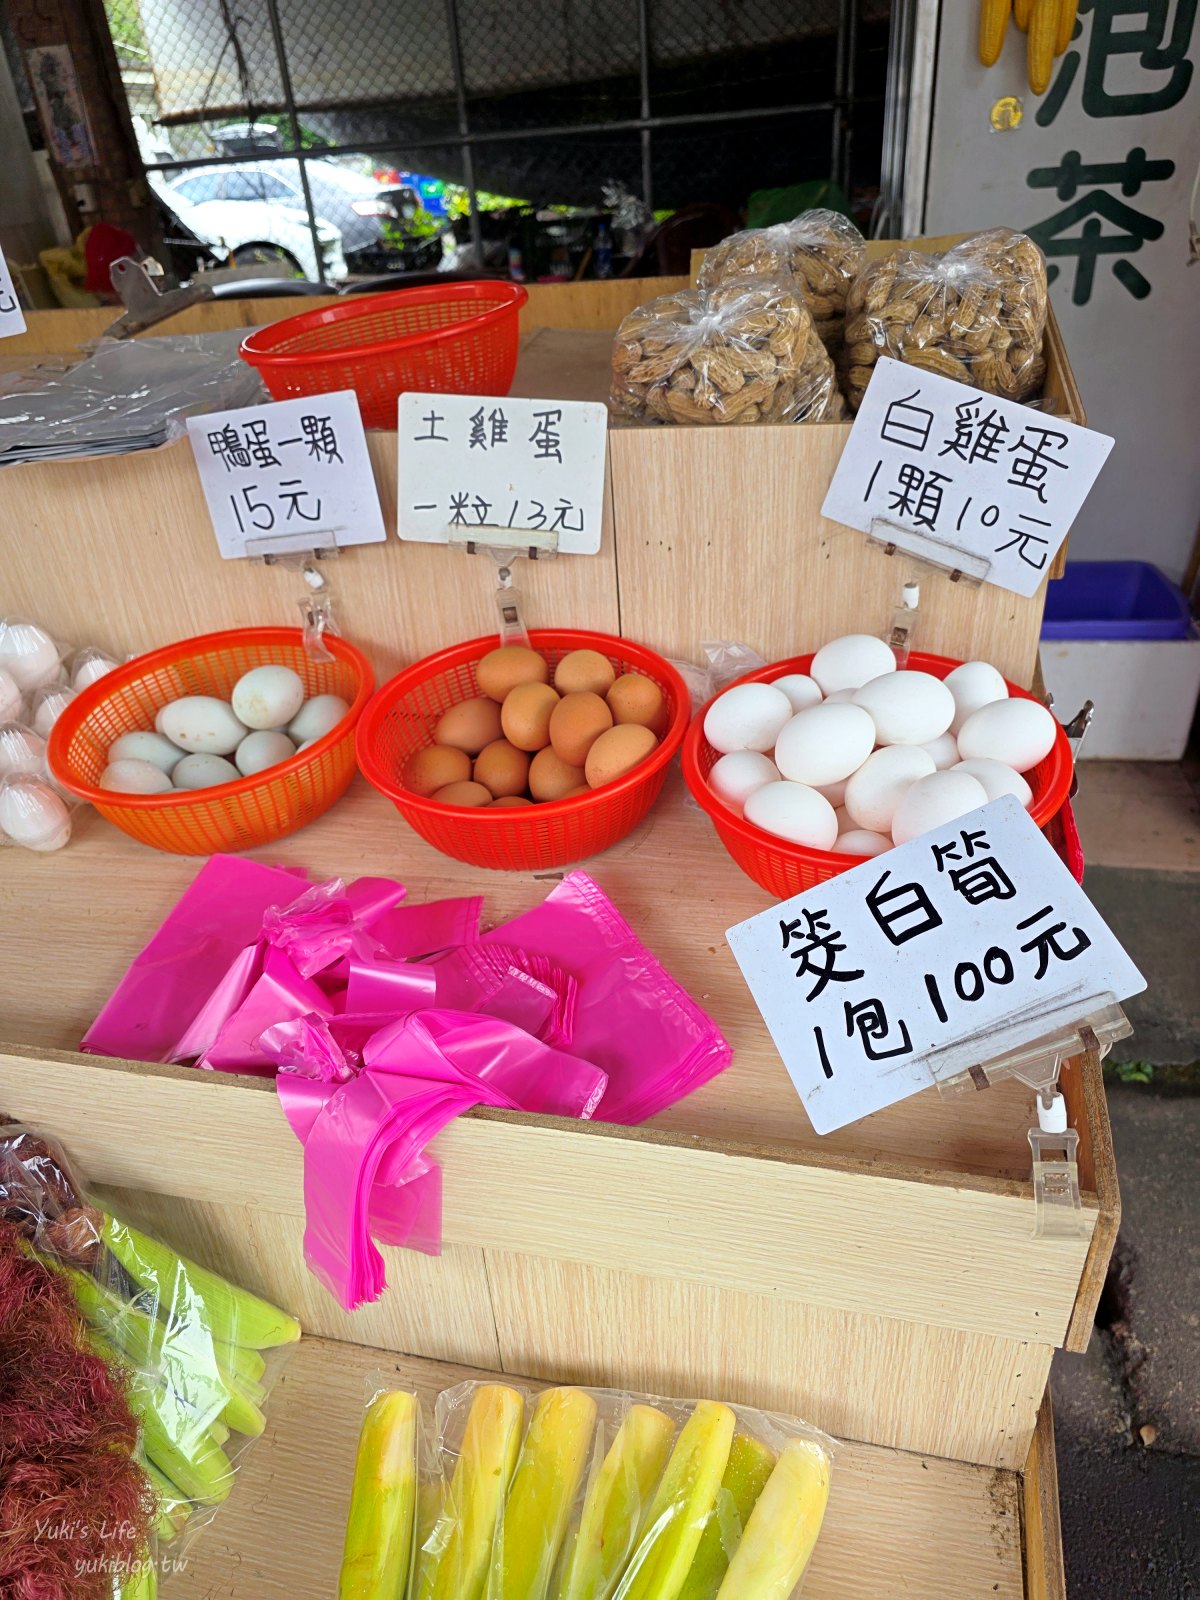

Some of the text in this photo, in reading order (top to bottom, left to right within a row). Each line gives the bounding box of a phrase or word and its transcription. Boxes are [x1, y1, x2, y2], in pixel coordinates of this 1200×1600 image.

[1021, 0, 1198, 306] 泡茶
[207, 414, 344, 473] 鴨蛋一顆
[413, 406, 563, 464] 土雞蛋
[880, 388, 1070, 504] 白雞蛋
[230, 478, 323, 534] 15元
[413, 491, 585, 533] 一粒13元
